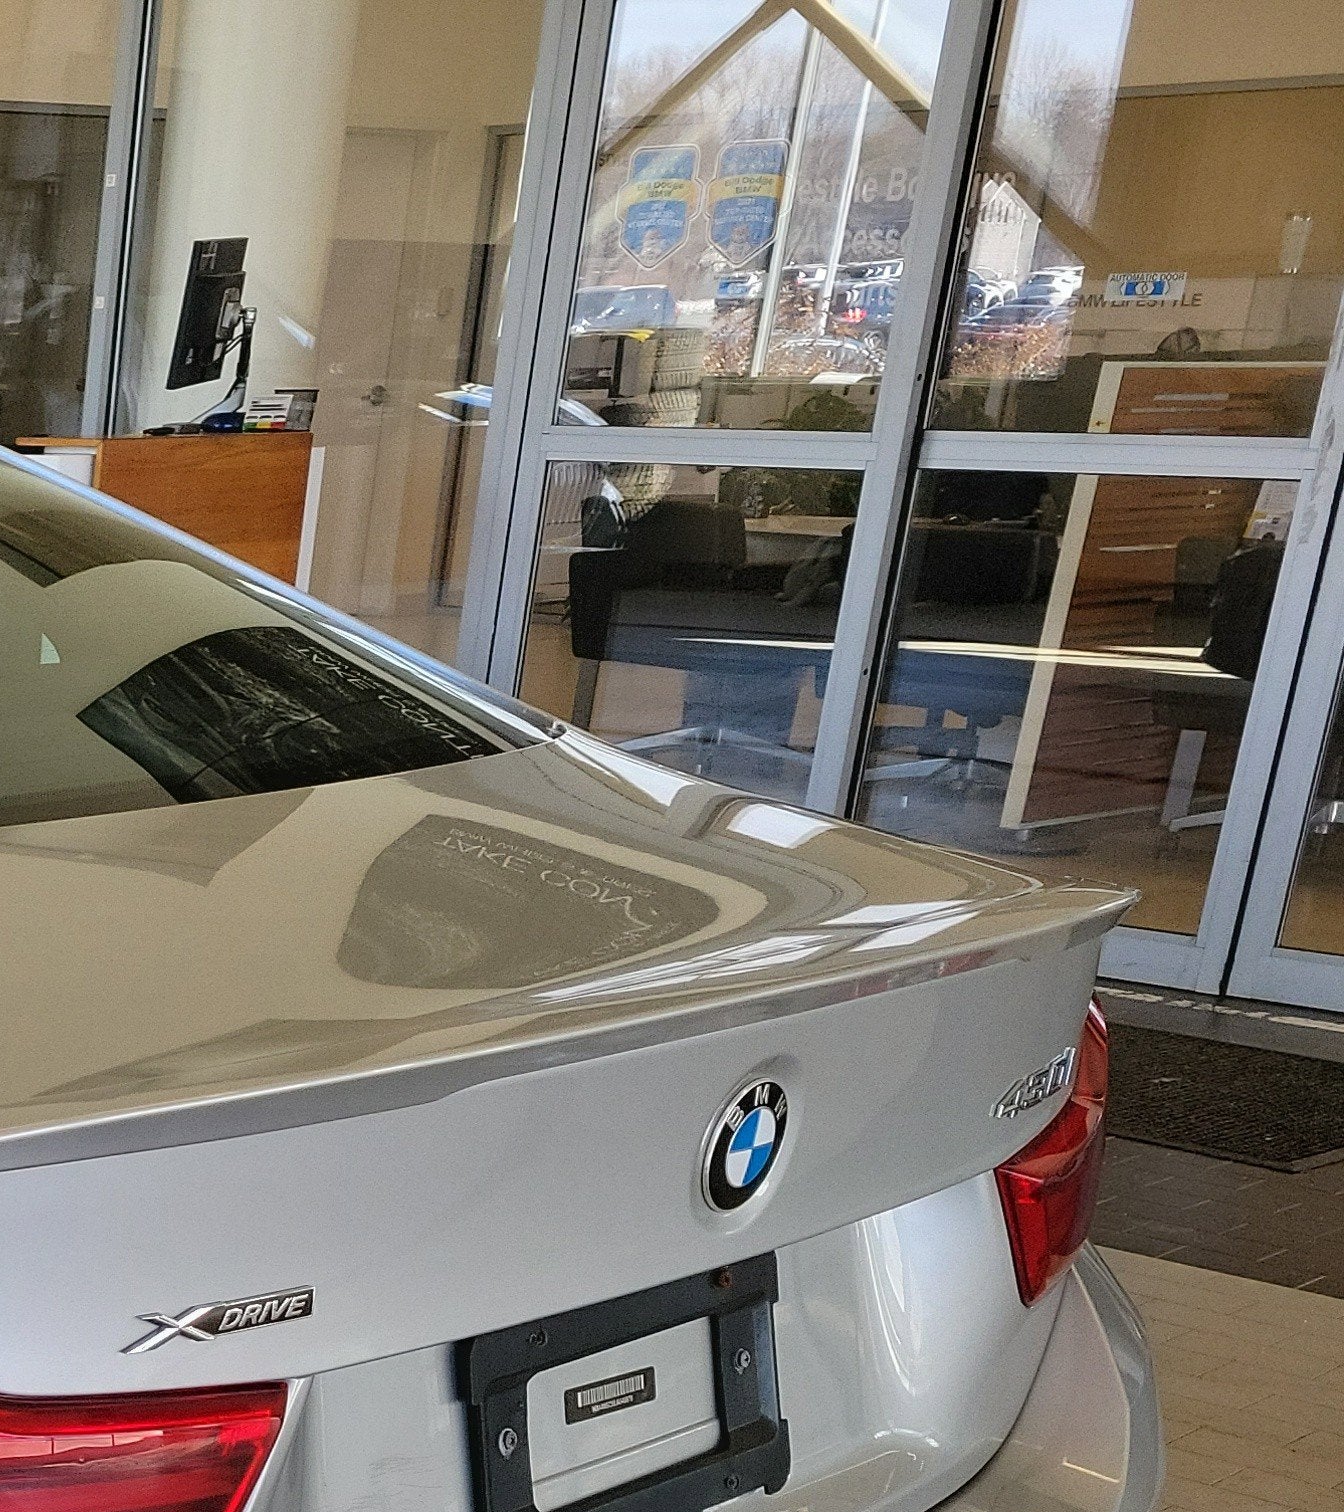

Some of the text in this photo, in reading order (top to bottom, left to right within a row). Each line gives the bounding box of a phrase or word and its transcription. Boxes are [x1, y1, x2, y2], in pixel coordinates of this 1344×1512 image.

[1111, 272, 1185, 282] AUTOMATIC DOOR
[727, 1083, 787, 1132] BMW
